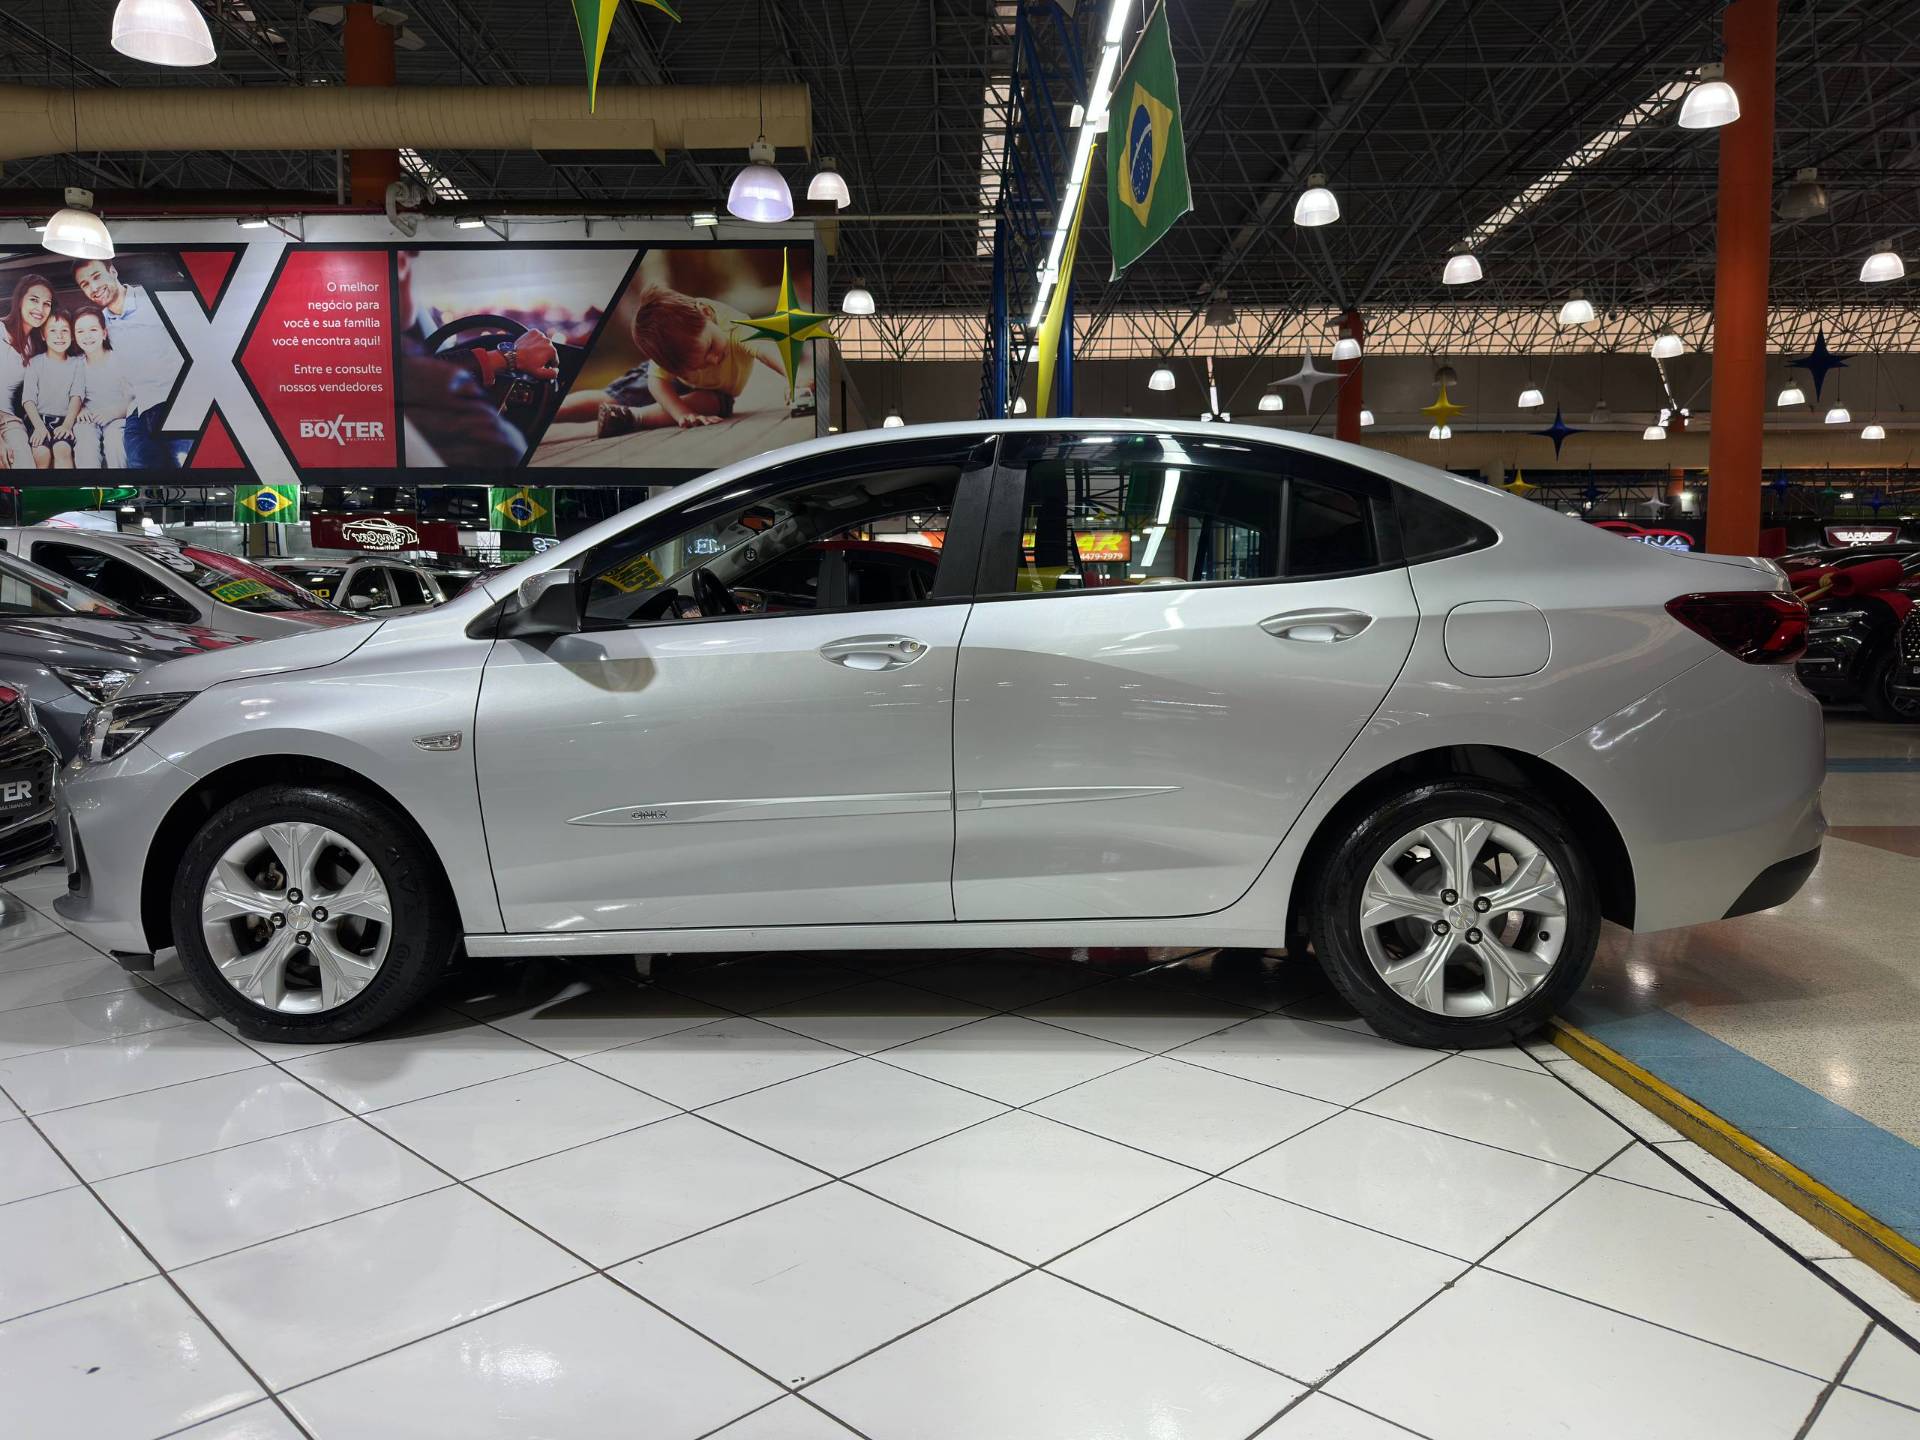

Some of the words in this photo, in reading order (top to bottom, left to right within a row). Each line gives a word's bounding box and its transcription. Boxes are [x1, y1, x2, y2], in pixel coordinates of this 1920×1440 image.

[327, 281, 337, 292] O
[339, 281, 379, 292] melhor
[308, 300, 353, 313] negócio
[355, 302, 380, 313] para
[284, 317, 311, 328] você
[313, 319, 320, 328] e
[322, 319, 341, 328] sua
[344, 317, 381, 328] família
[272, 335, 299, 346] você
[302, 335, 351, 346] encontra
[354, 335, 381, 349] aqui!
[294, 363, 323, 374] Entre
[325, 366, 333, 374] e
[335, 363, 383, 374] consulte
[279, 383, 317, 393] nossos
[319, 381, 384, 392] vendedores
[300, 414, 385, 446] BOXTER
